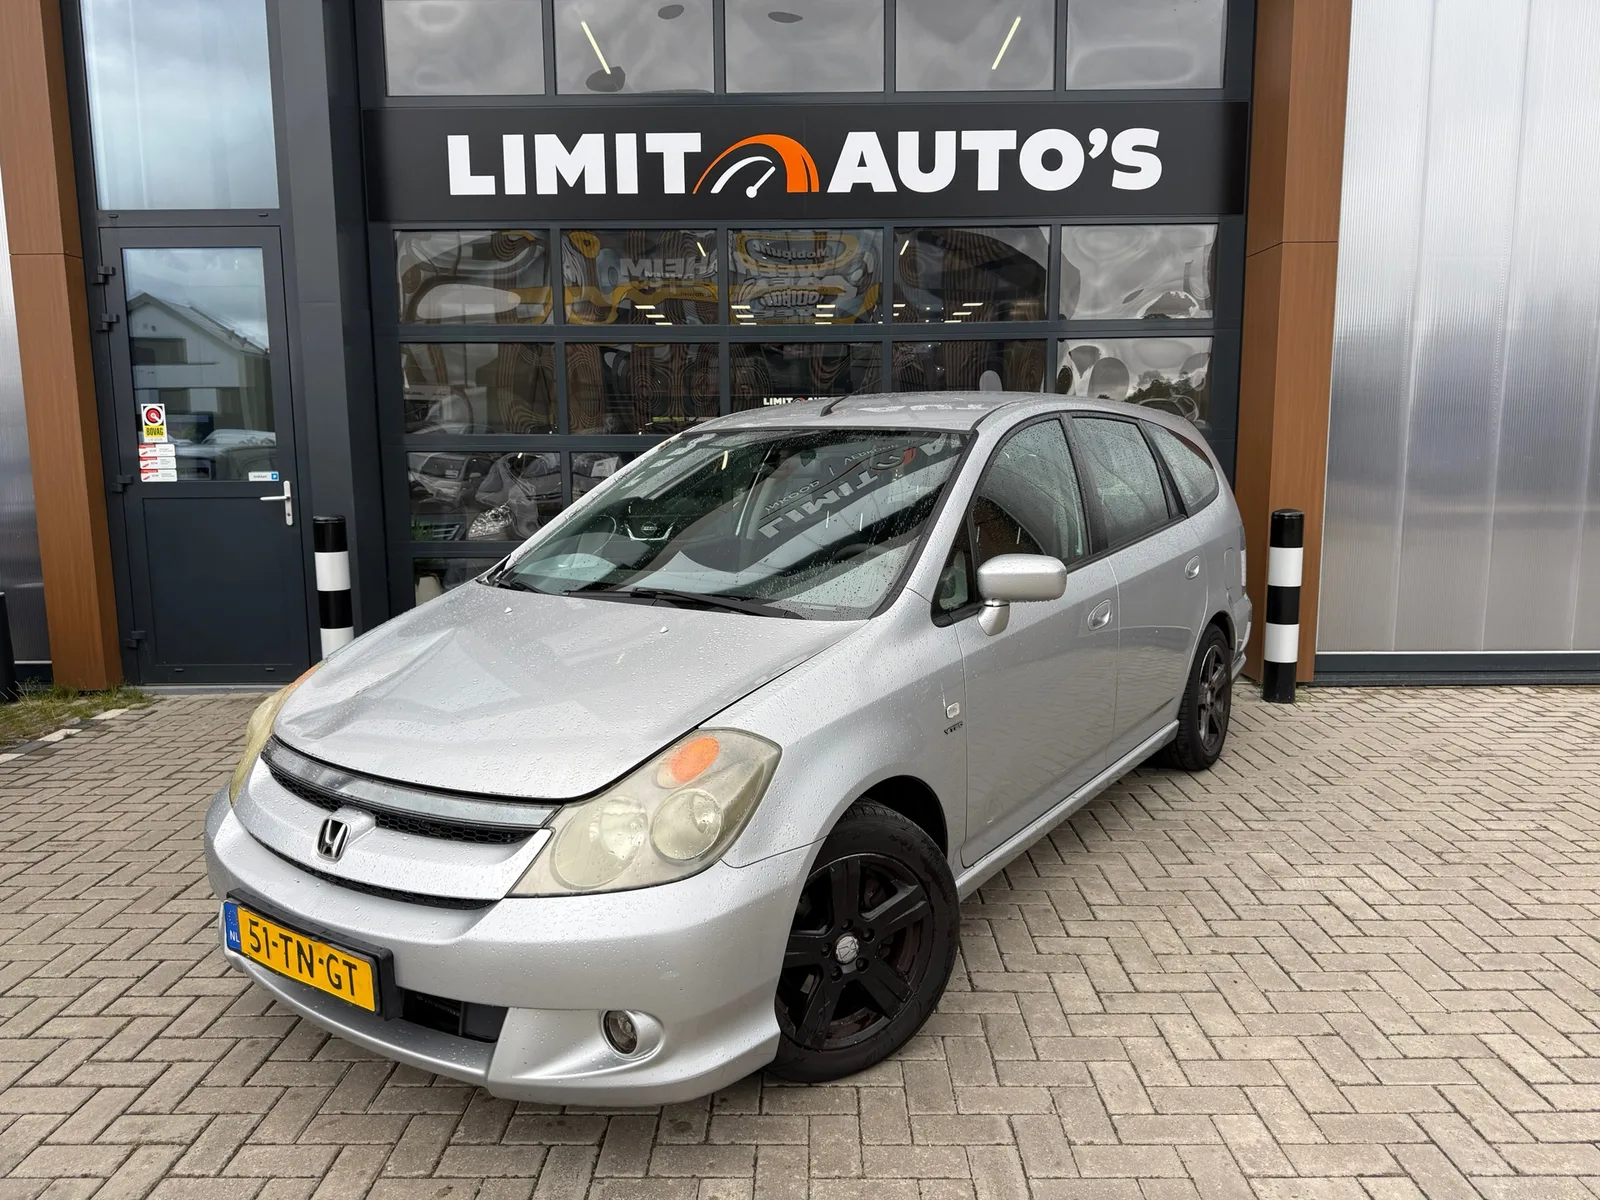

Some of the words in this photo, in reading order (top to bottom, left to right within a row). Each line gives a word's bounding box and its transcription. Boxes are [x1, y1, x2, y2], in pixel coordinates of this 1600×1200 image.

[447, 132, 702, 195] LIMIT
[763, 397, 793, 406] LIMIT
[146, 427, 164, 436] BOVAG
[229, 930, 241, 944] NL
[248, 918, 358, 997] 51-TN-GT
